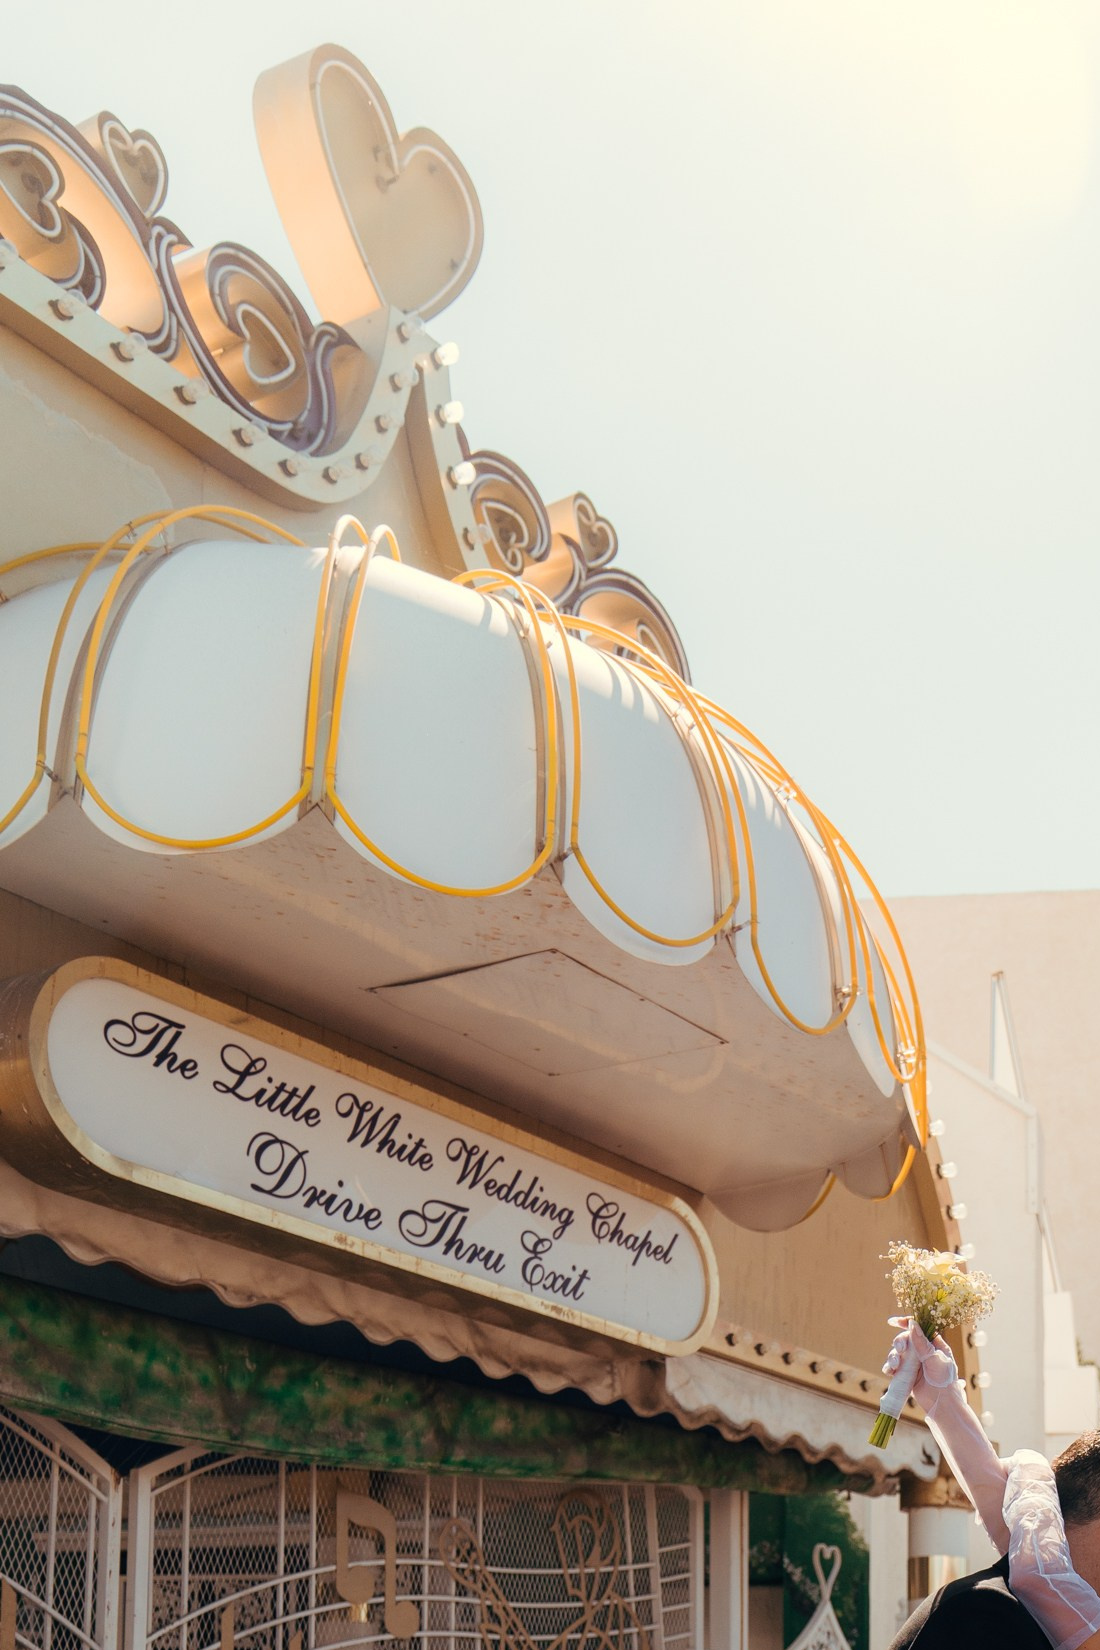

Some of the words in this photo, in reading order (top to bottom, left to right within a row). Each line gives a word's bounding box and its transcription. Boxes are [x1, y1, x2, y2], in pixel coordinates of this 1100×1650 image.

[103, 1011, 199, 1080] The
[211, 1043, 322, 1127] Little
[335, 1092, 434, 1172] White
[446, 1137, 575, 1239] Wedding
[586, 1192, 678, 1265] Chapel
[246, 1131, 383, 1231] Drive
[398, 1199, 506, 1274] Thru
[520, 1230, 591, 1301] Exit
